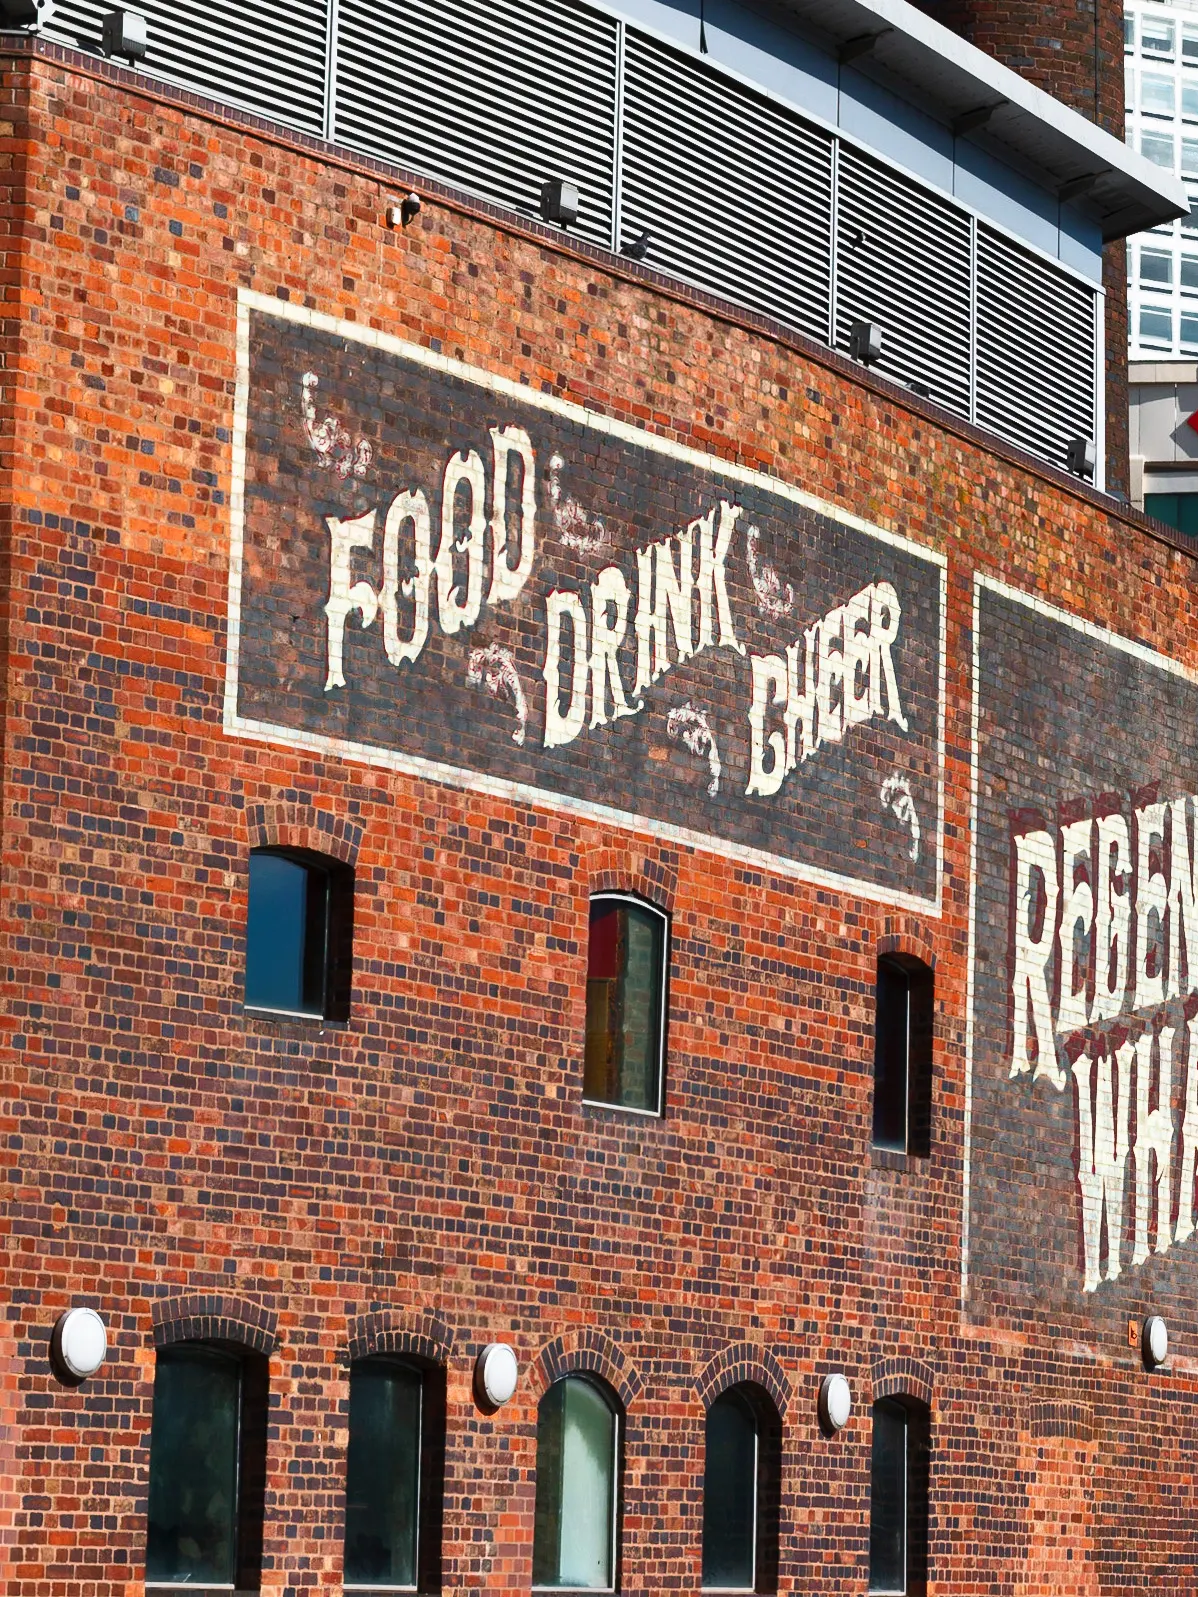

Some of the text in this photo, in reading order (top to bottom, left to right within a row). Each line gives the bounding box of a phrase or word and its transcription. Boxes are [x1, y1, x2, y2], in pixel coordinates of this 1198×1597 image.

[323, 423, 909, 797] FOOD DRINK CHEER
